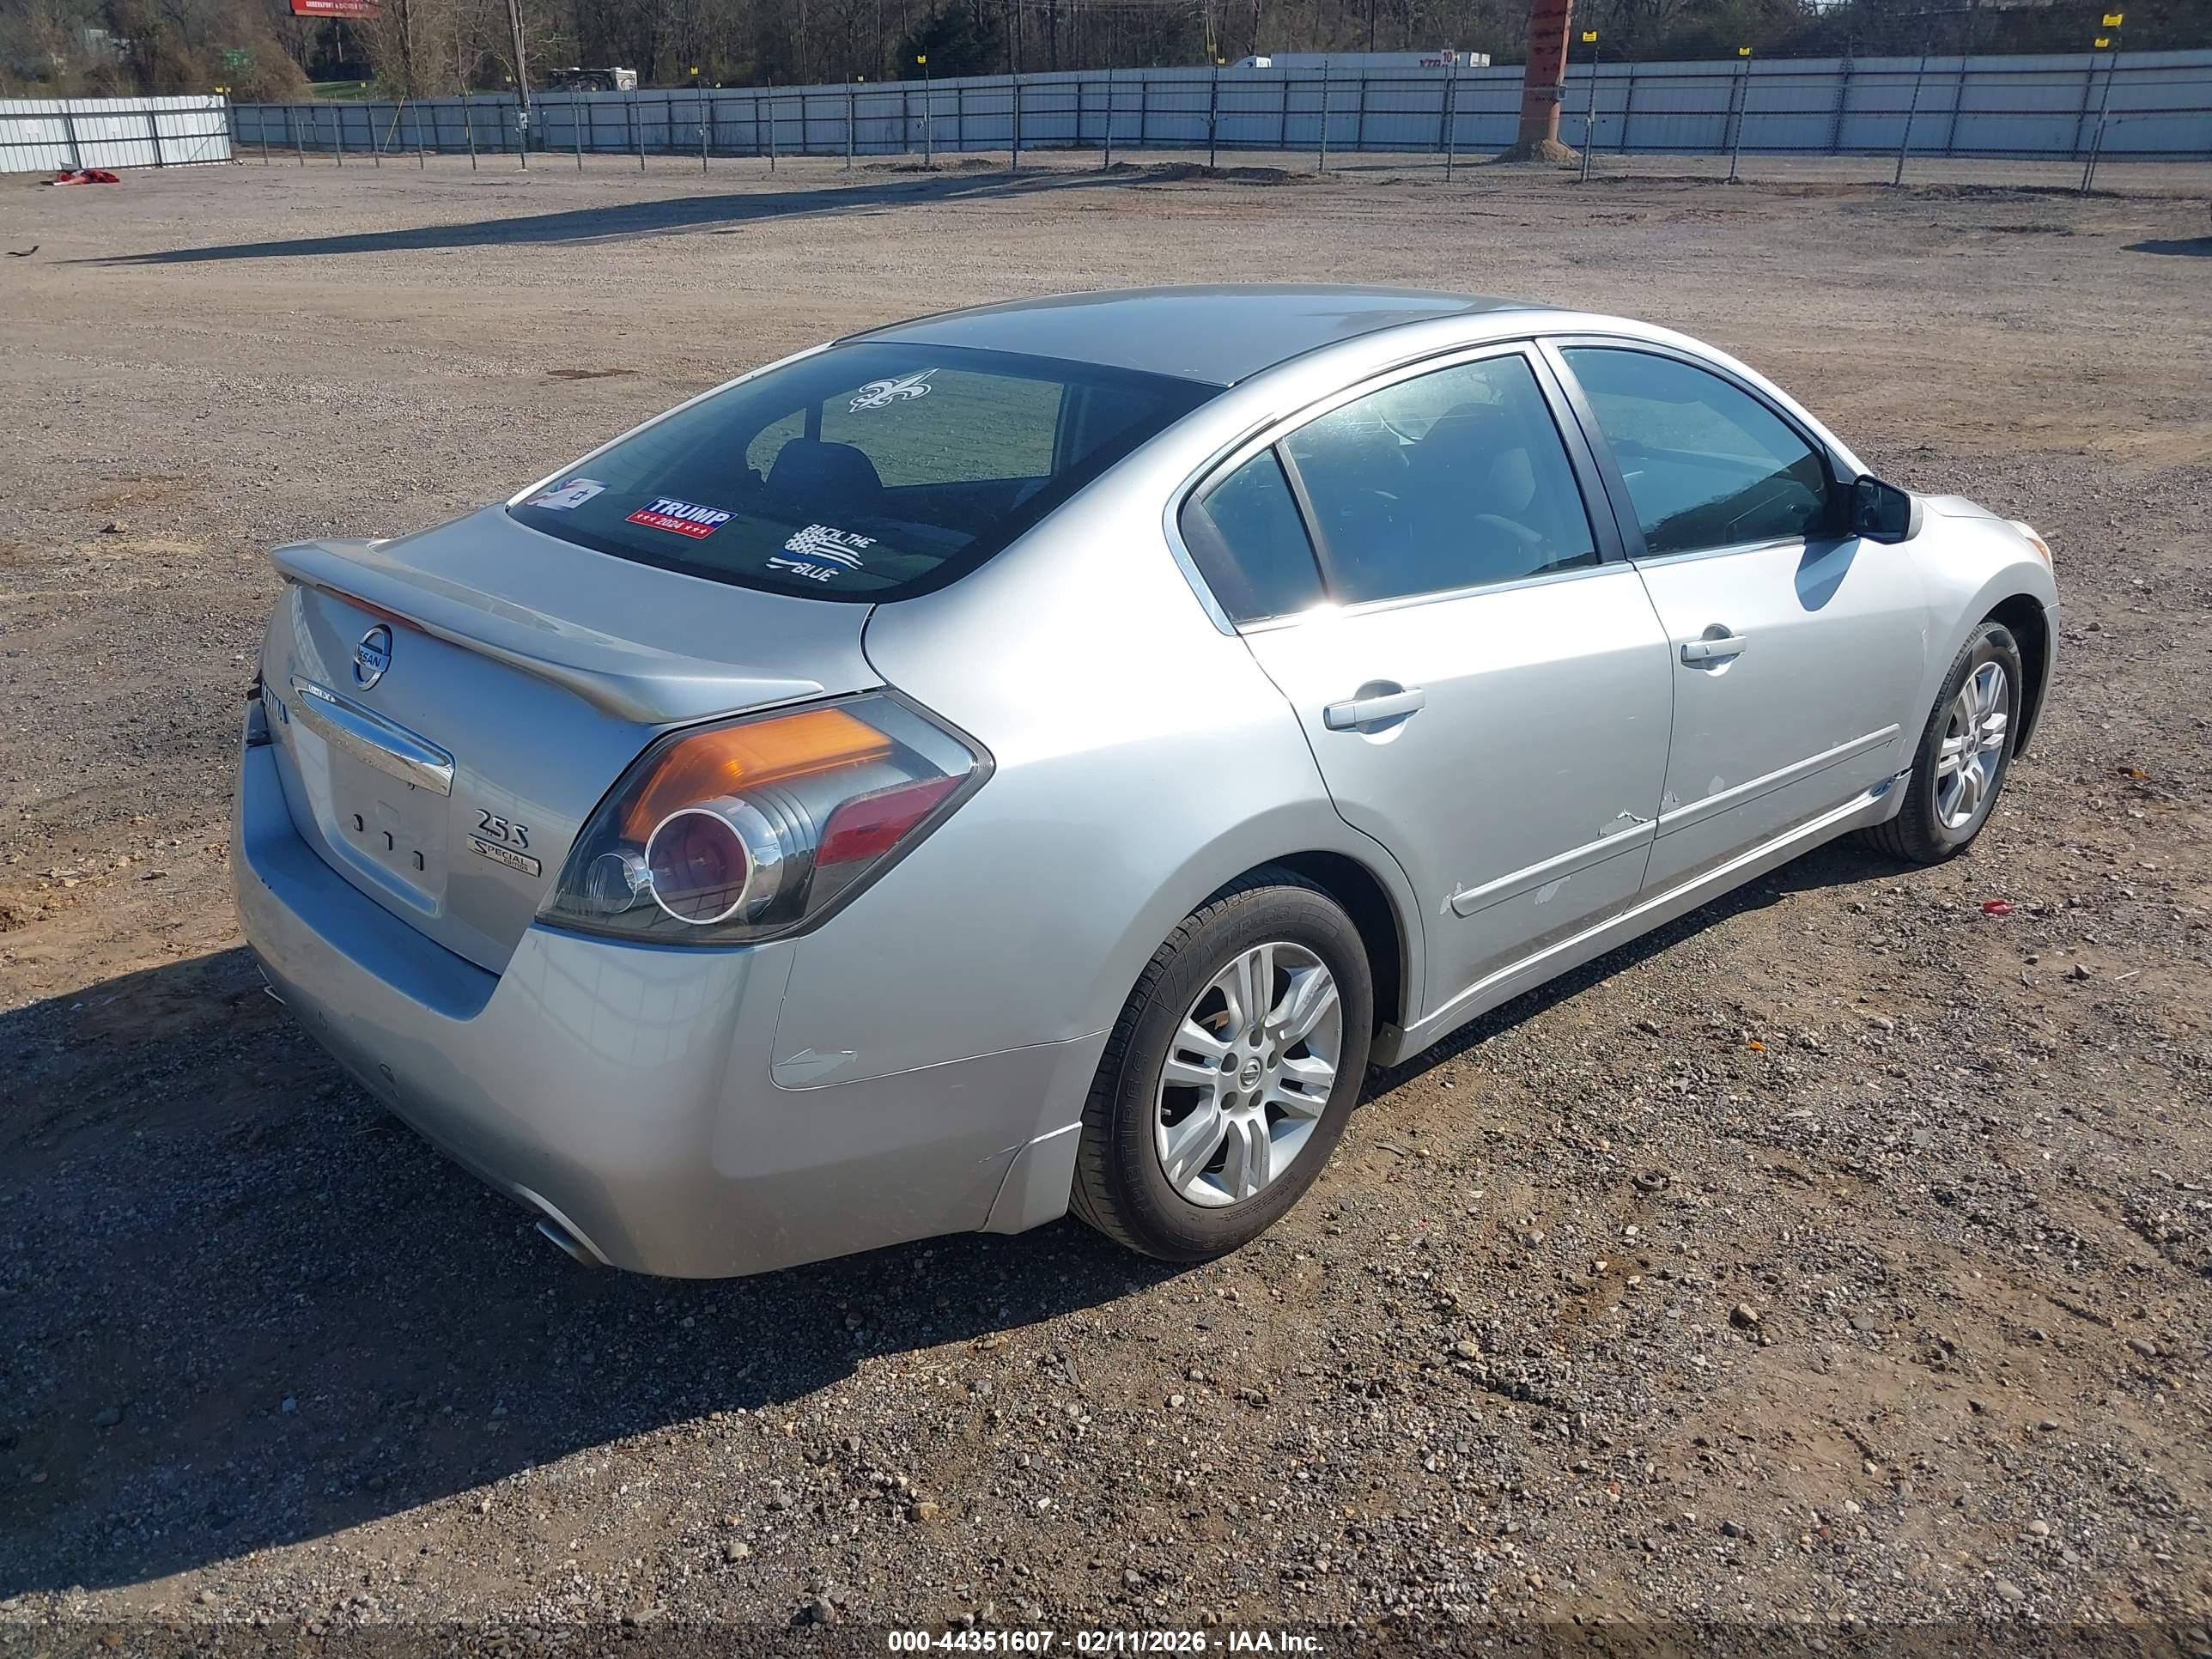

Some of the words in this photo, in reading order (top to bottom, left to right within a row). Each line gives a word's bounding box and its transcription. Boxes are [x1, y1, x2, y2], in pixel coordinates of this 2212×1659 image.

[1443, 52, 1453, 63] 10
[650, 499, 730, 526] TRUMP
[655, 517, 684, 529] 2024
[802, 524, 847, 540] BACK
[842, 533, 878, 548] THE
[791, 562, 840, 582] BLUE
[358, 646, 382, 667] SSAN
[473, 840, 528, 866] SPECIAL
